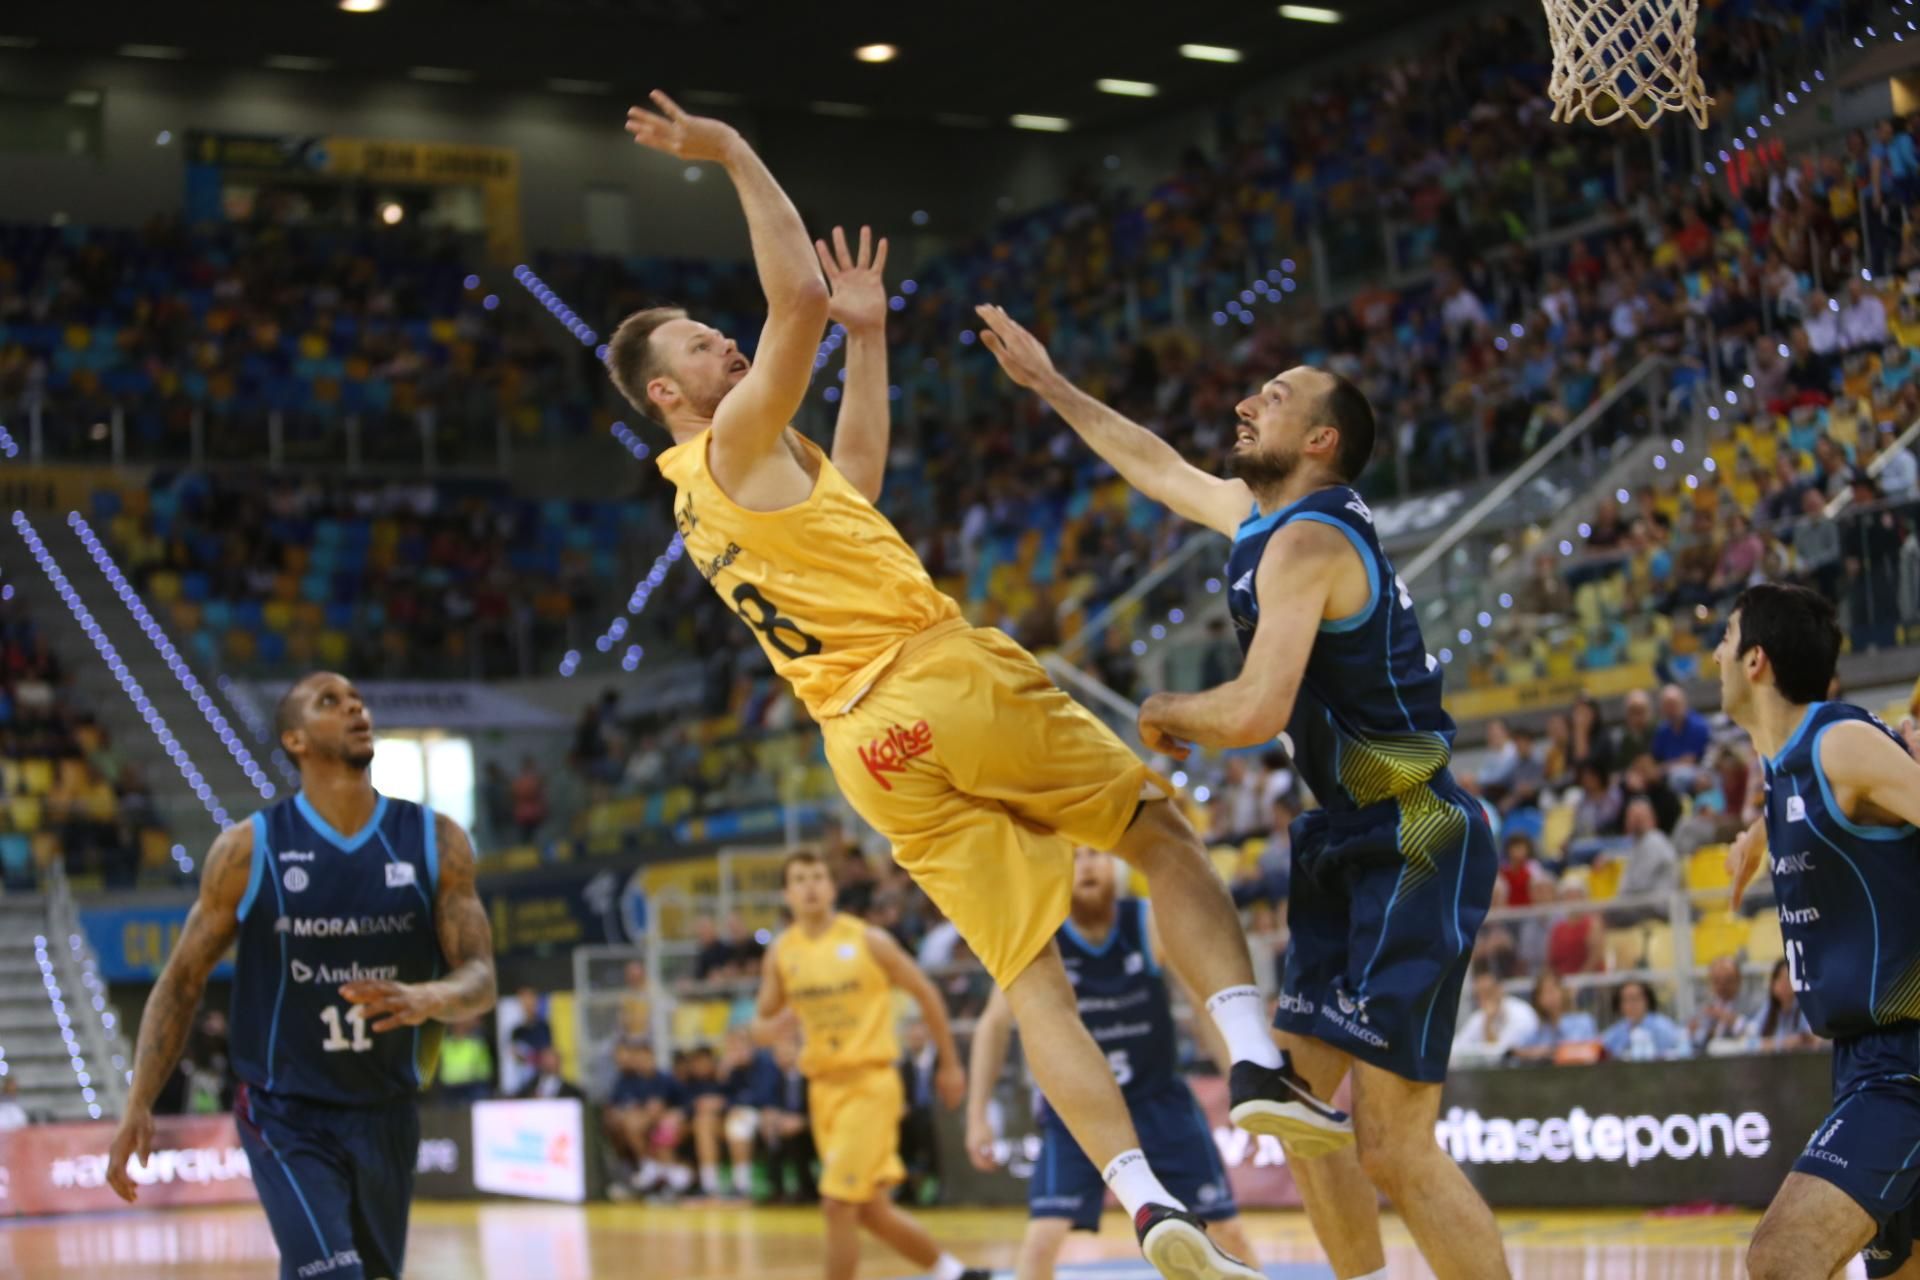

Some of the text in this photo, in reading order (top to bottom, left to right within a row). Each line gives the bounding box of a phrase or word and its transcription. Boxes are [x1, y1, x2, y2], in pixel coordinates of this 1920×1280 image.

[732, 582, 822, 660] 8
[857, 719, 933, 791] Kalise
[294, 912, 416, 937] MORABANC
[319, 1002, 373, 1052] 11
